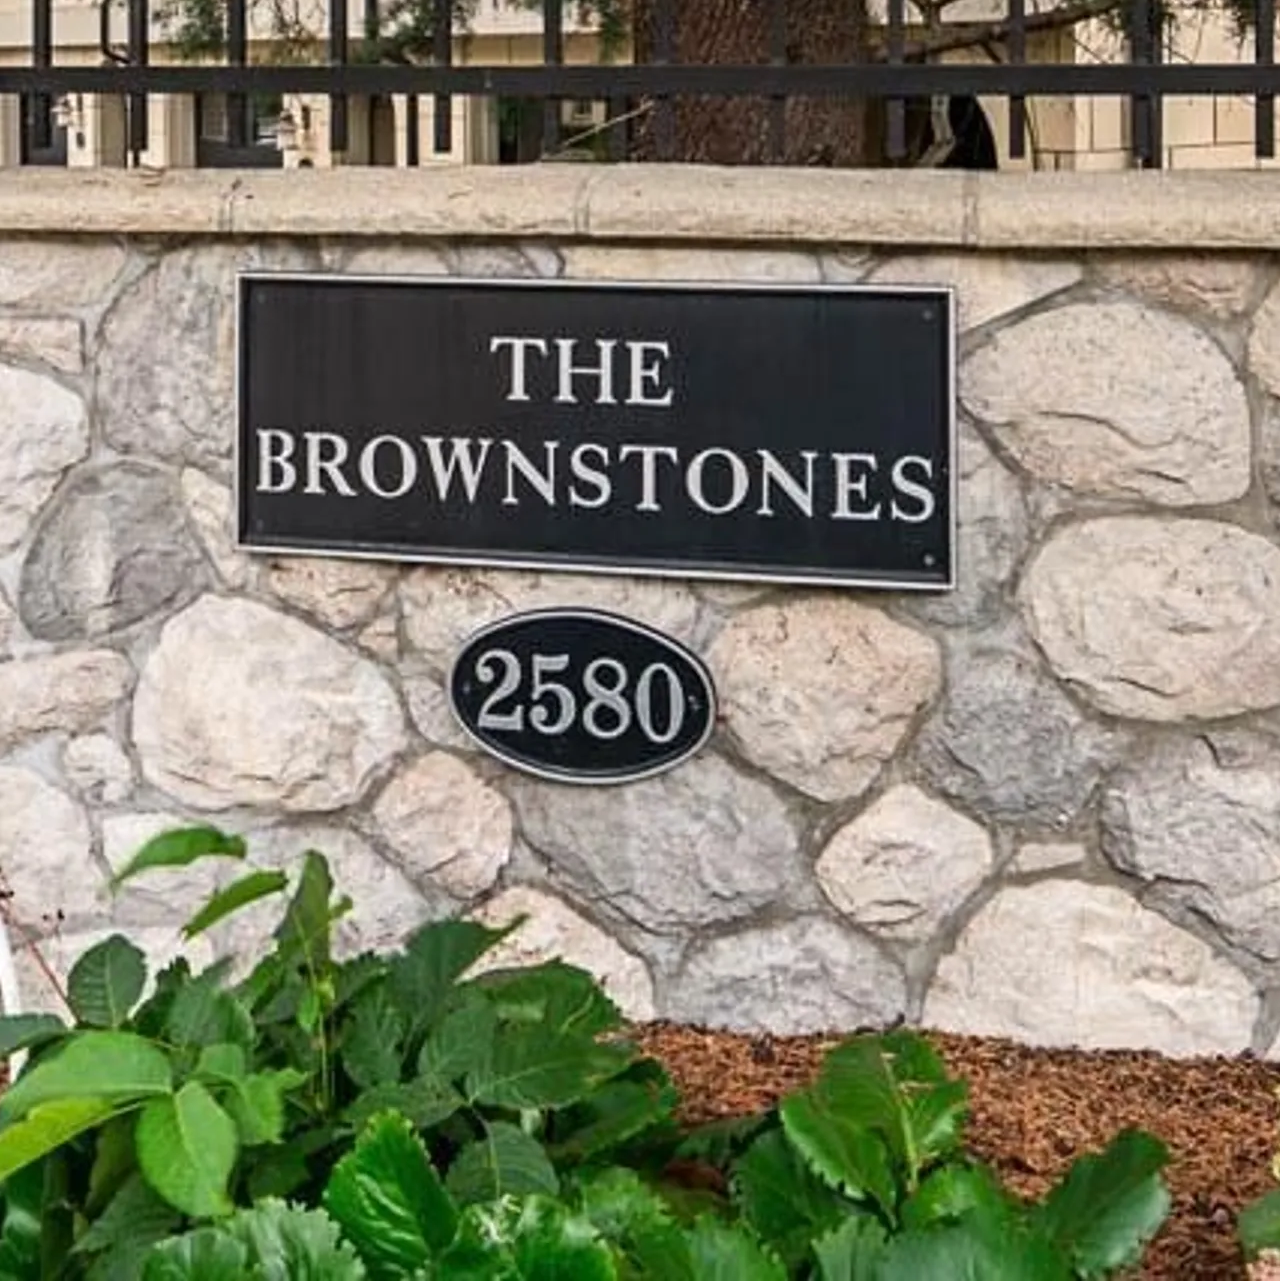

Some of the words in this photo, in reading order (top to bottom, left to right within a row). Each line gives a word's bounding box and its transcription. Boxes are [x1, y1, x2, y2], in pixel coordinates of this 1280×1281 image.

[489, 336, 674, 407] THE
[255, 428, 935, 523] BROWNSTONES
[475, 649, 685, 744] 2580
